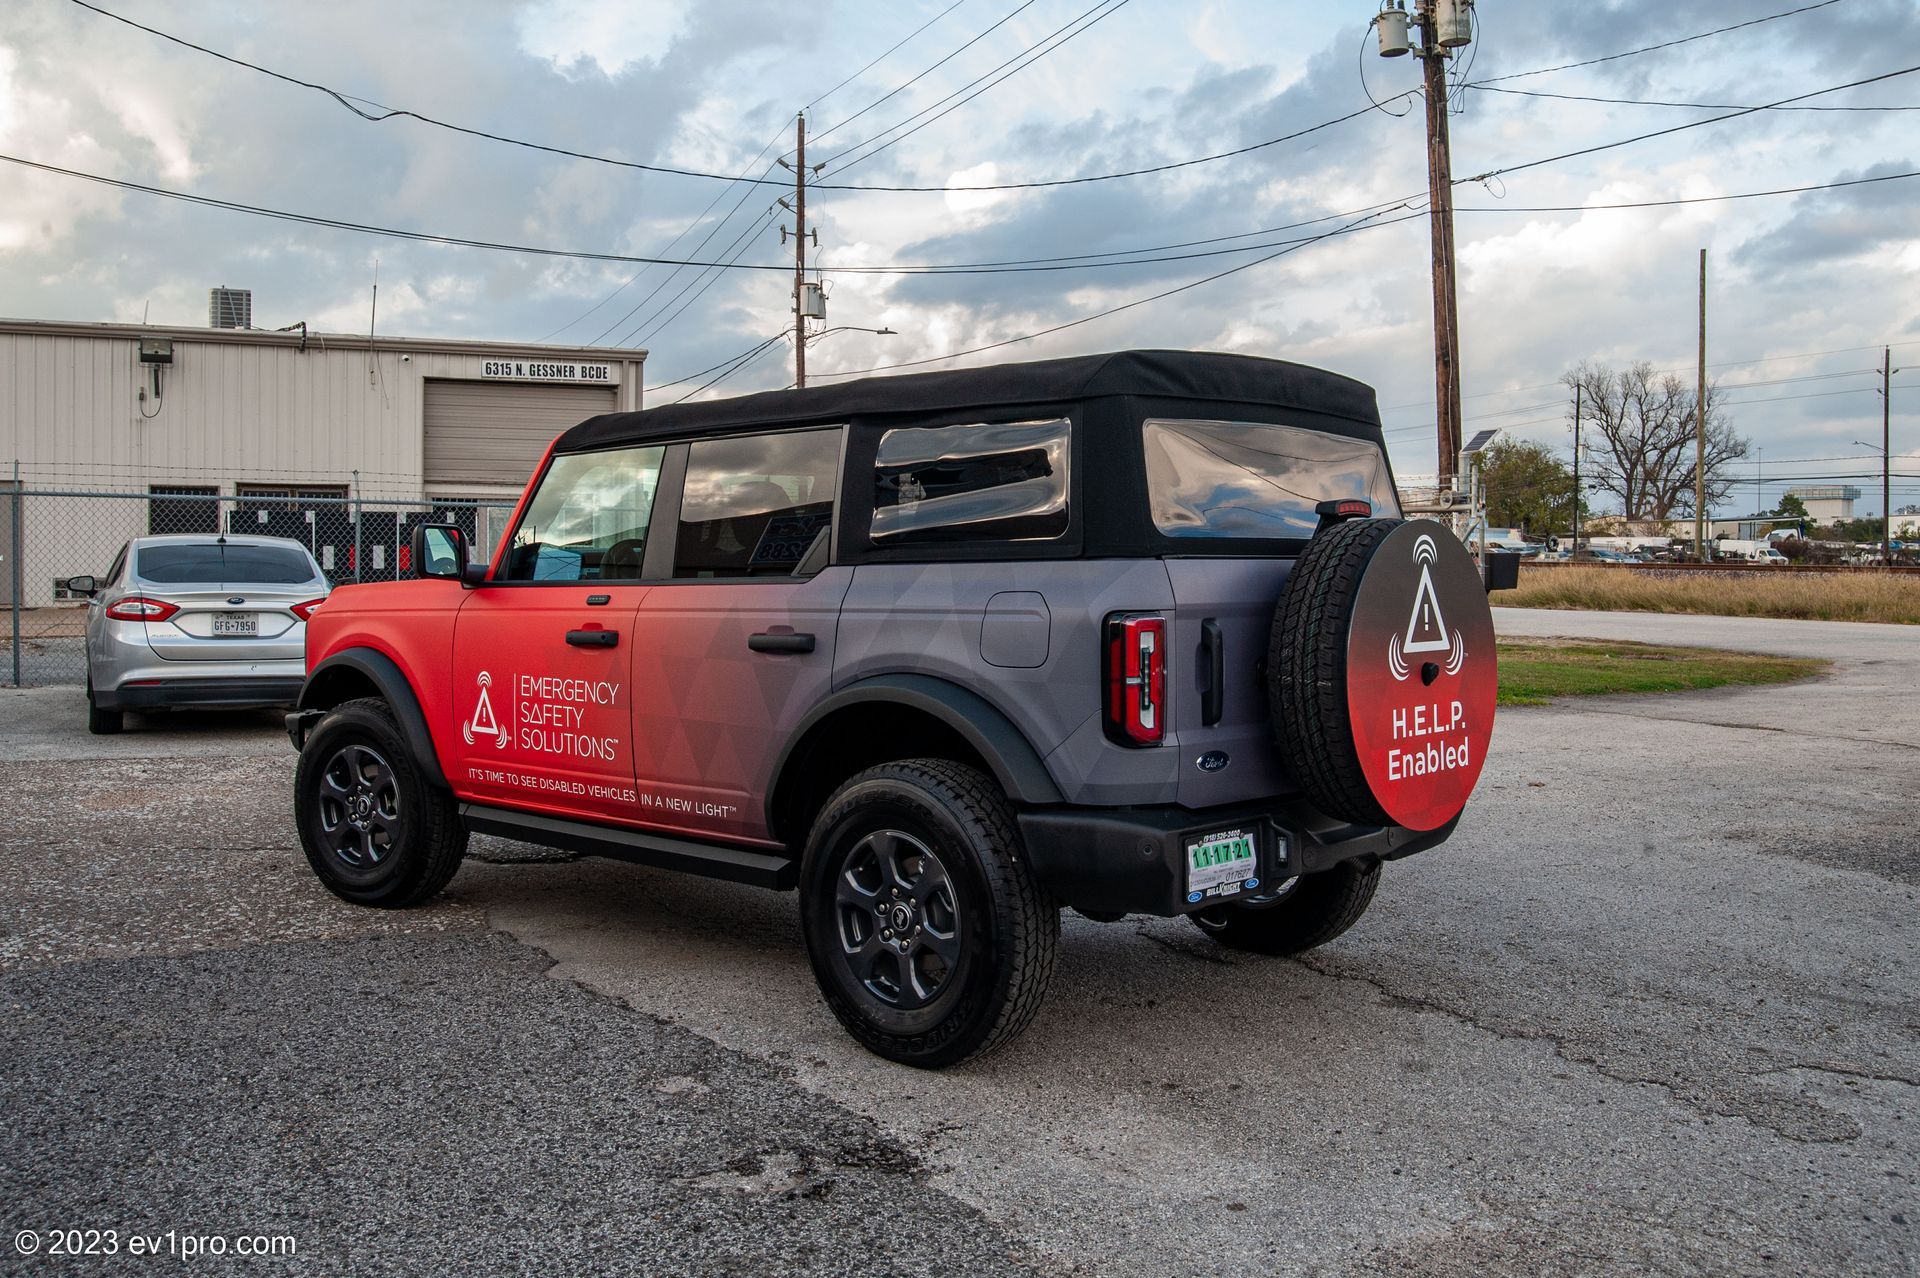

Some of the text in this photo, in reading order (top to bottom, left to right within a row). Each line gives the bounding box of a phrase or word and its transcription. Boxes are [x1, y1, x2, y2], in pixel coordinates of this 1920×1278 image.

[485, 362, 608, 380] 6315 N. GESSNER BCDE
[520, 675, 620, 705] EMERGENCY
[520, 702, 584, 729] SAFETY
[1392, 701, 1466, 740] H.E.L.P.
[1388, 736, 1470, 781] Enabled
[468, 768, 484, 781] IT'S
[485, 770, 505, 784] TIME
[506, 773, 519, 785] TO
[521, 775, 538, 788] SEE
[540, 778, 585, 795] DISABLED
[588, 785, 636, 802] VEHICLES
[641, 794, 652, 806] IN
[655, 796, 663, 808] A
[666, 798, 692, 812] NEW
